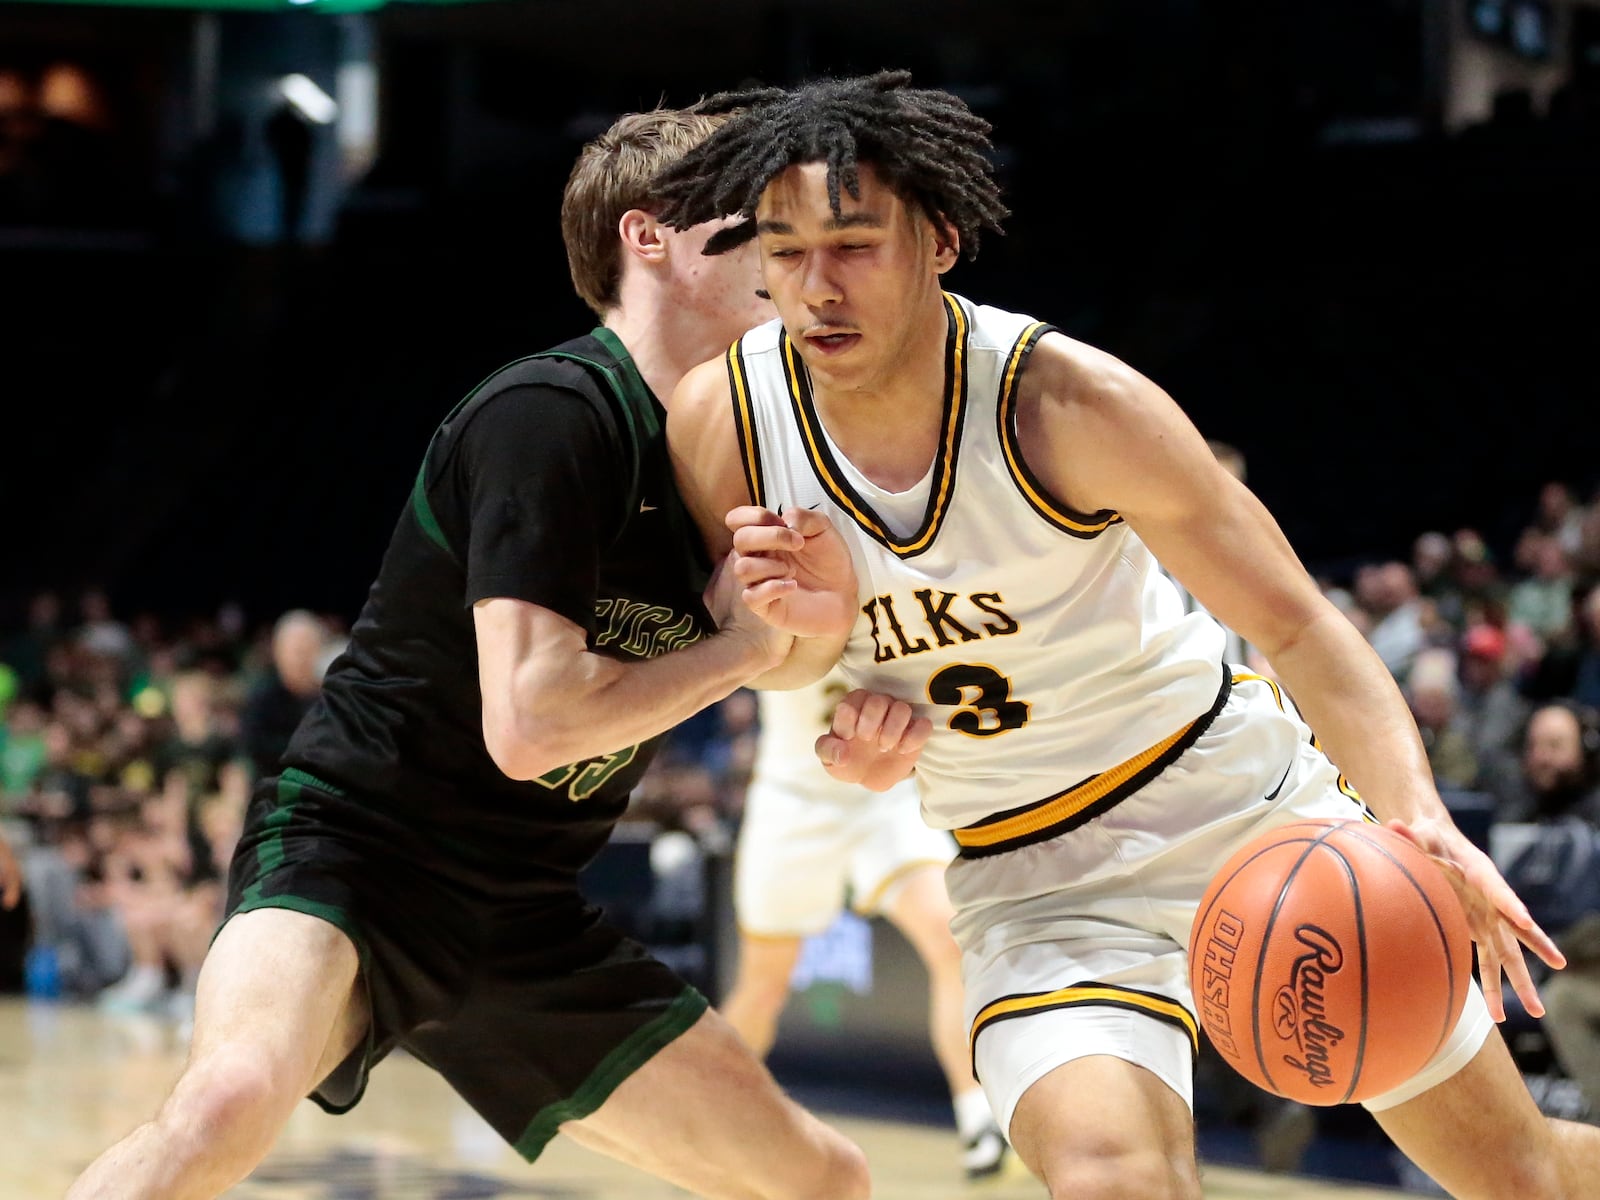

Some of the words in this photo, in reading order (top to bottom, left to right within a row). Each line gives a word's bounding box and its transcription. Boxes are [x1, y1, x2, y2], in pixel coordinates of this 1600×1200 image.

[862, 588, 1022, 664] ELKS
[925, 661, 1033, 740] 3
[1203, 908, 1245, 1059] OHSAA
[1283, 923, 1345, 1089] Rawlings
